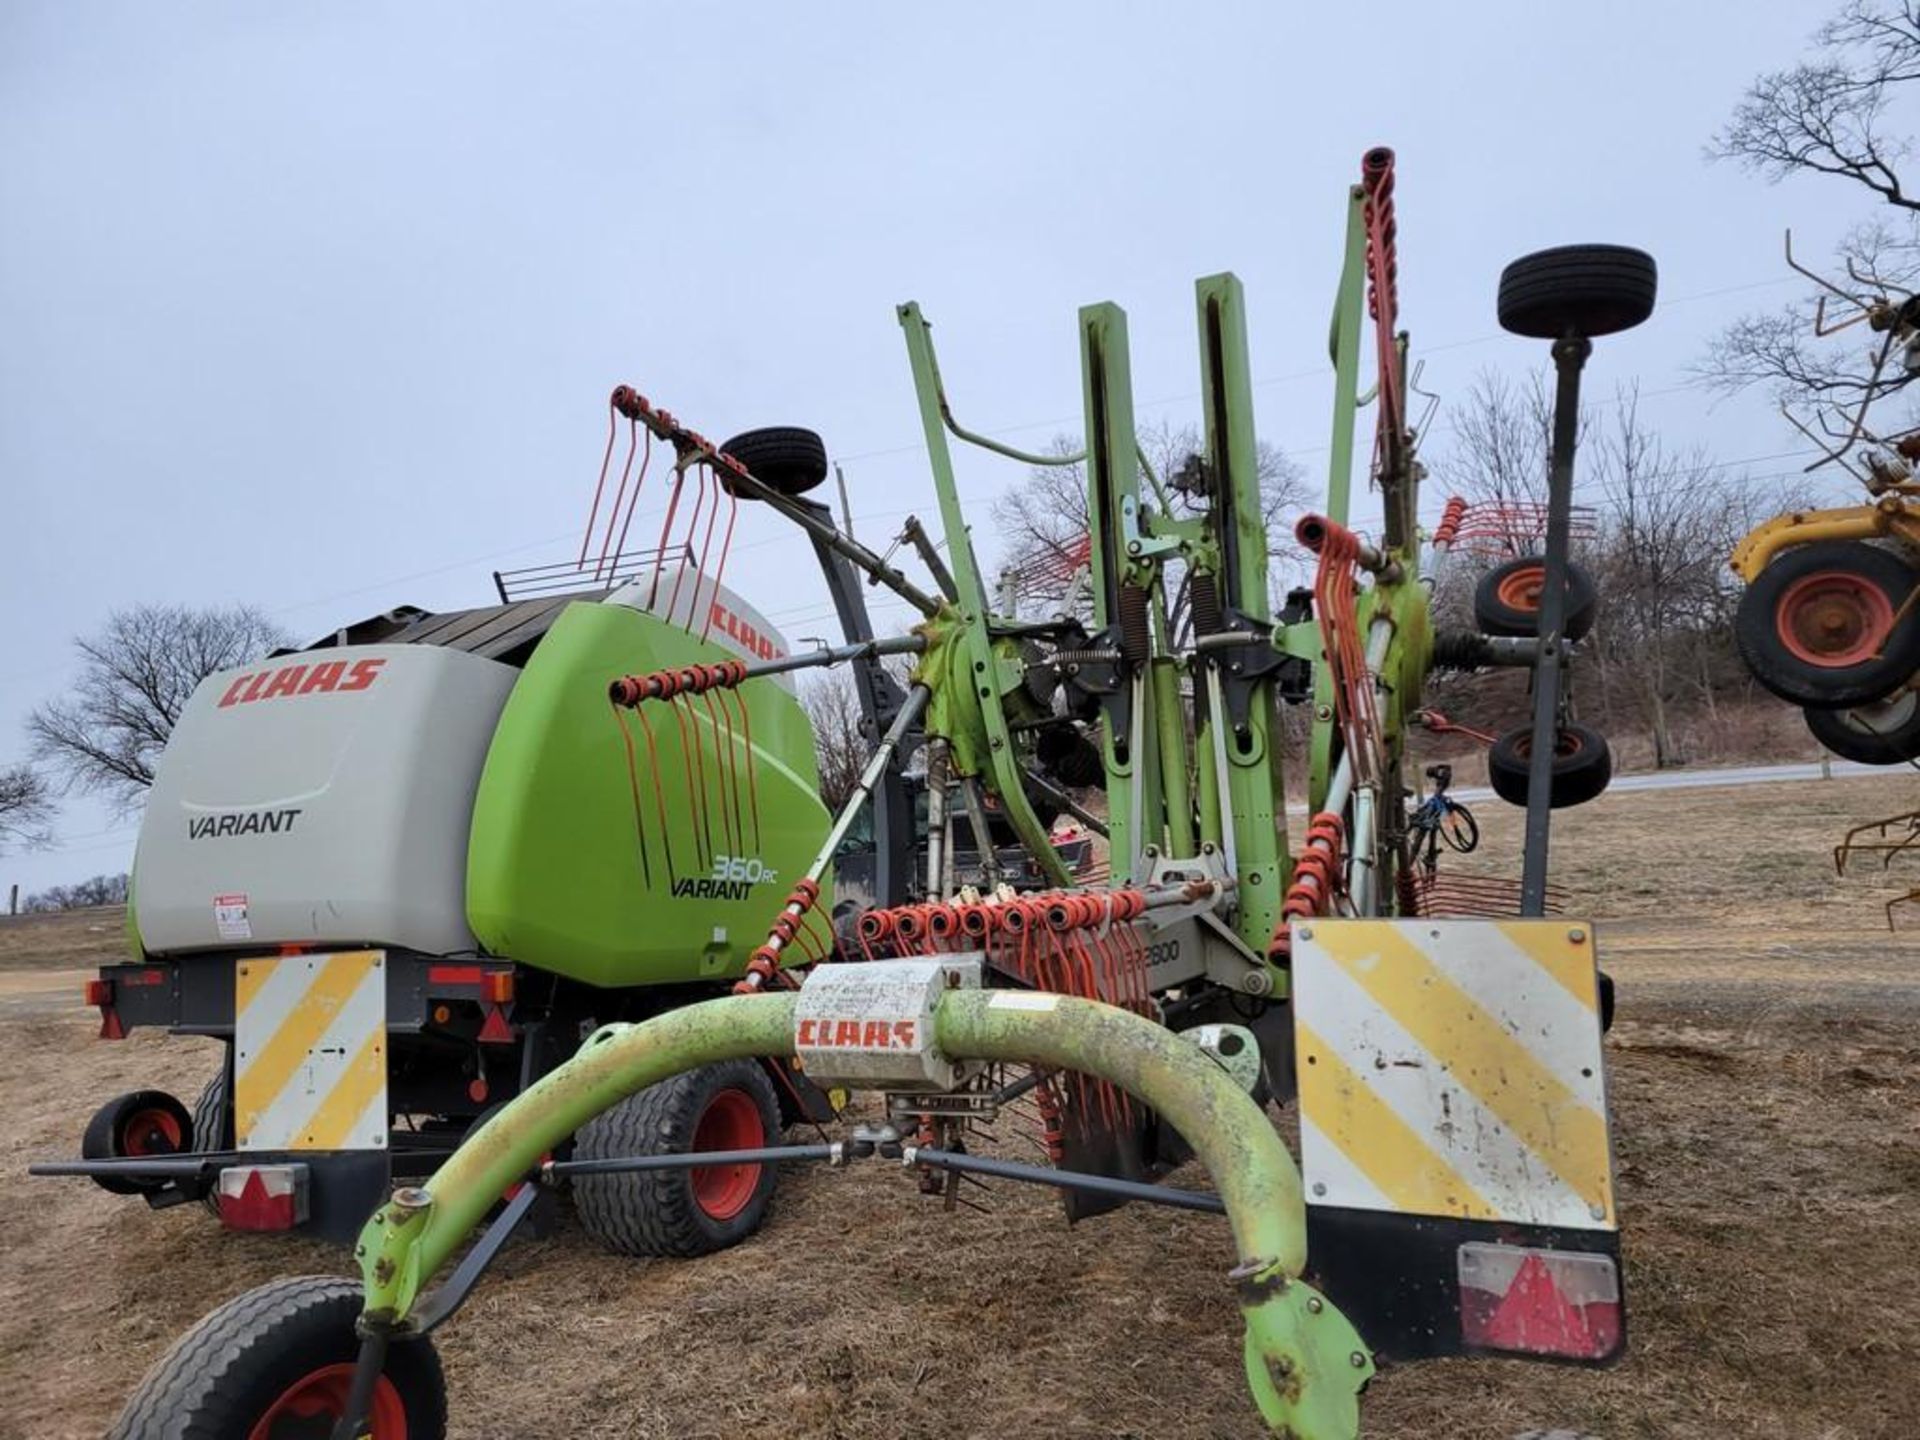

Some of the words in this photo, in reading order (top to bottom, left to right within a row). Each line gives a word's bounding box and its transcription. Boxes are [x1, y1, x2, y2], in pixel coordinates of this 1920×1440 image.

[217, 658, 387, 708] CLAAS
[189, 809, 302, 840] VARIANT
[671, 878, 753, 901] VARIANT
[798, 1019, 914, 1049] CLAAS
